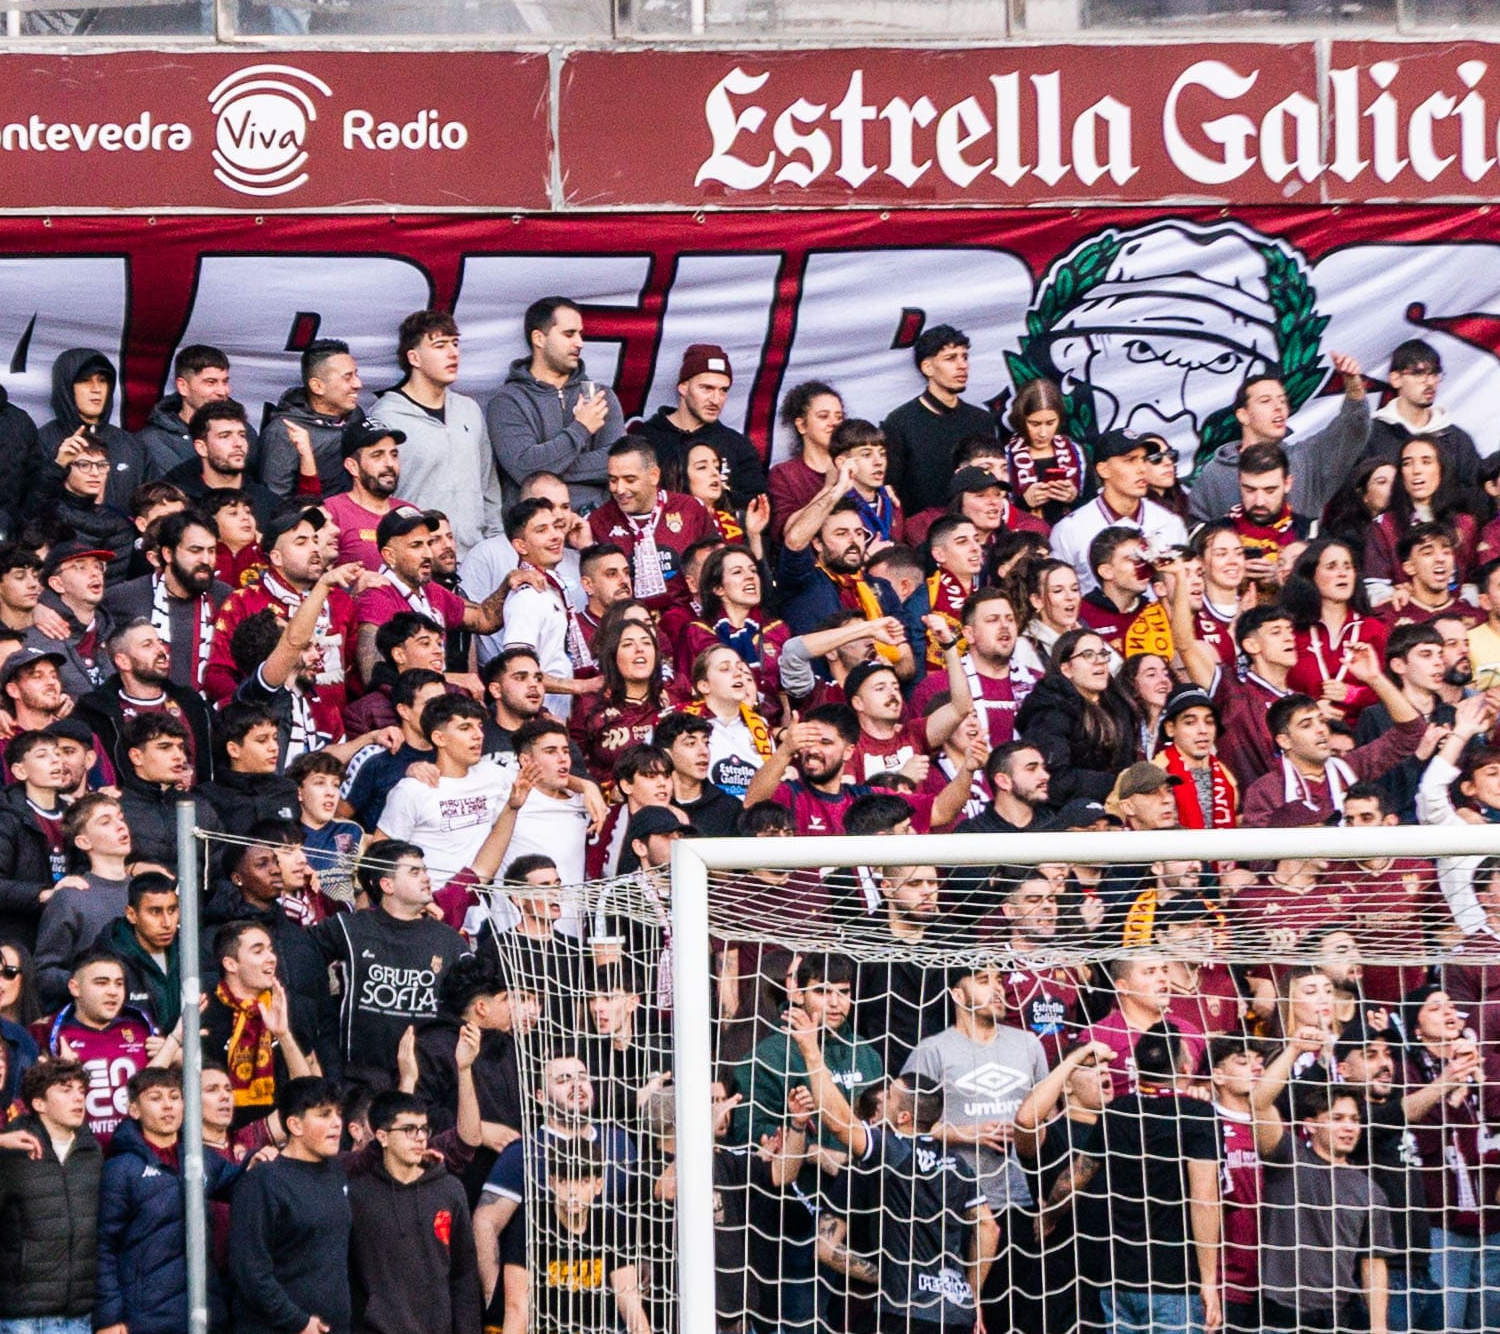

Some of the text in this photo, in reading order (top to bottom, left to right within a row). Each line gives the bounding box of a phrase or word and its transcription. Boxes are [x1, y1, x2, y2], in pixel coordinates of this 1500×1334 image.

[224, 110, 300, 154] Viva
[341, 107, 469, 151] Radio
[694, 65, 1140, 192] Estrella
[368, 963, 436, 987] GRUPO
[964, 1098, 1023, 1117] umbr
